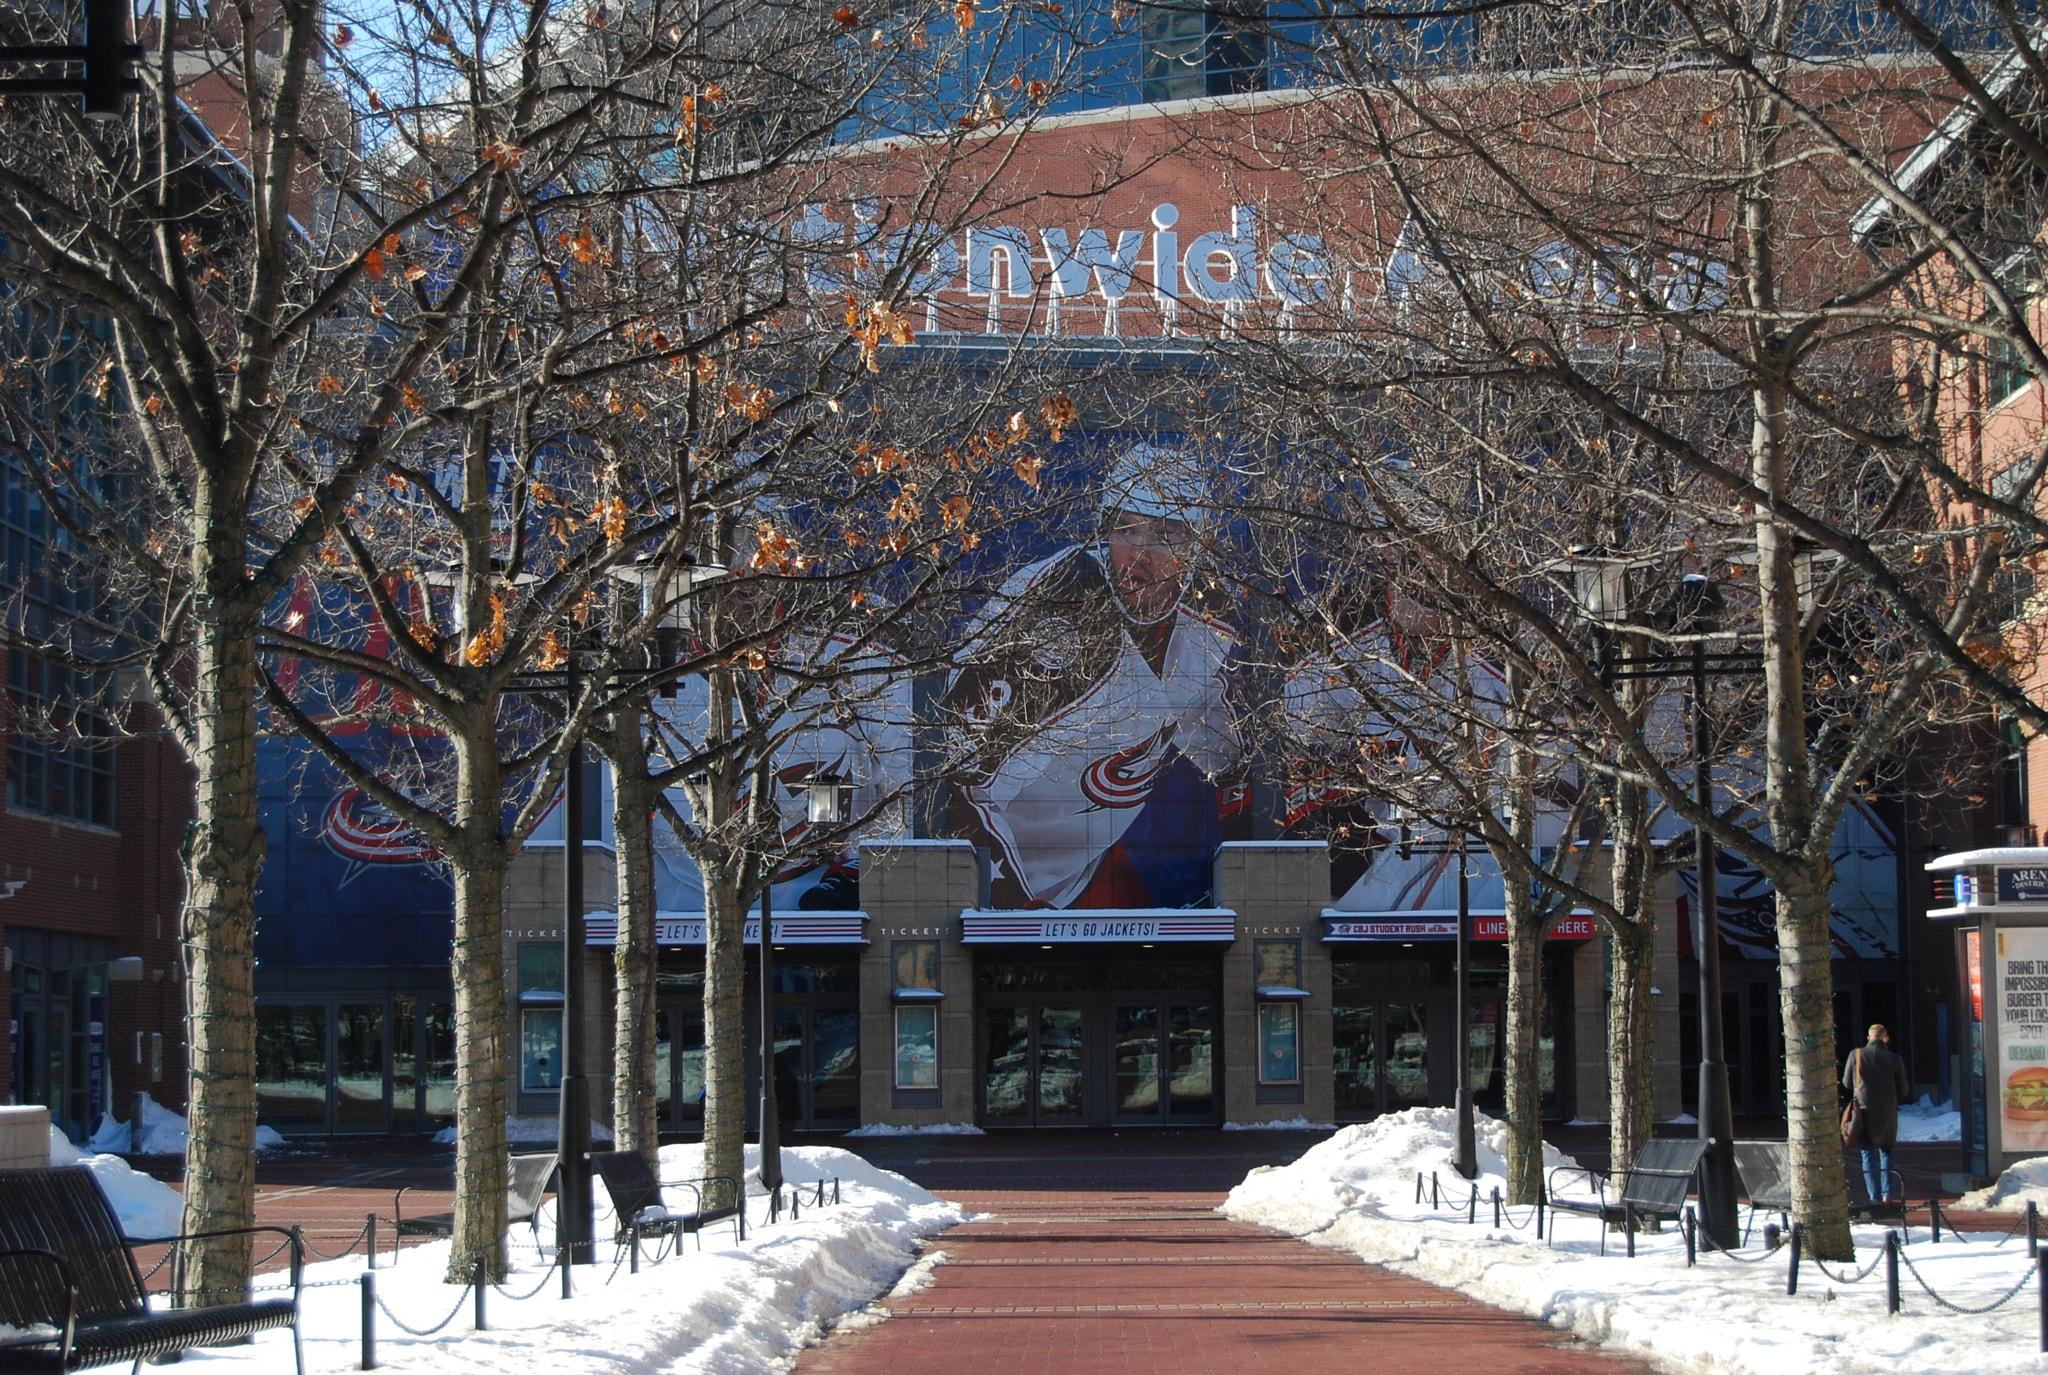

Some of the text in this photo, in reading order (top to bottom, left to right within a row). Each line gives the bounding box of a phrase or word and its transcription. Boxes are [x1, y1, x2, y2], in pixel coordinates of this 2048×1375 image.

[1385, 208, 1728, 312] Aena
[2012, 869, 2048, 883] AREN
[2014, 880, 2048, 889] DISTRIC
[667, 925, 700, 938] LET'S
[1045, 923, 1155, 936] LET'S GO JACKETS!
[1243, 927, 1311, 935] TICKET
[1353, 925, 1369, 933] CBJ
[1370, 925, 1404, 933] STUDENT
[1406, 925, 1426, 933] RUSH
[1478, 922, 1506, 934] LINE
[1557, 921, 1589, 933] HERE
[507, 930, 566, 938] TICKE
[2008, 961, 2034, 975] BRING
[2007, 993, 2042, 1007] BURGER
[2005, 1009, 2029, 1023] YOUR
